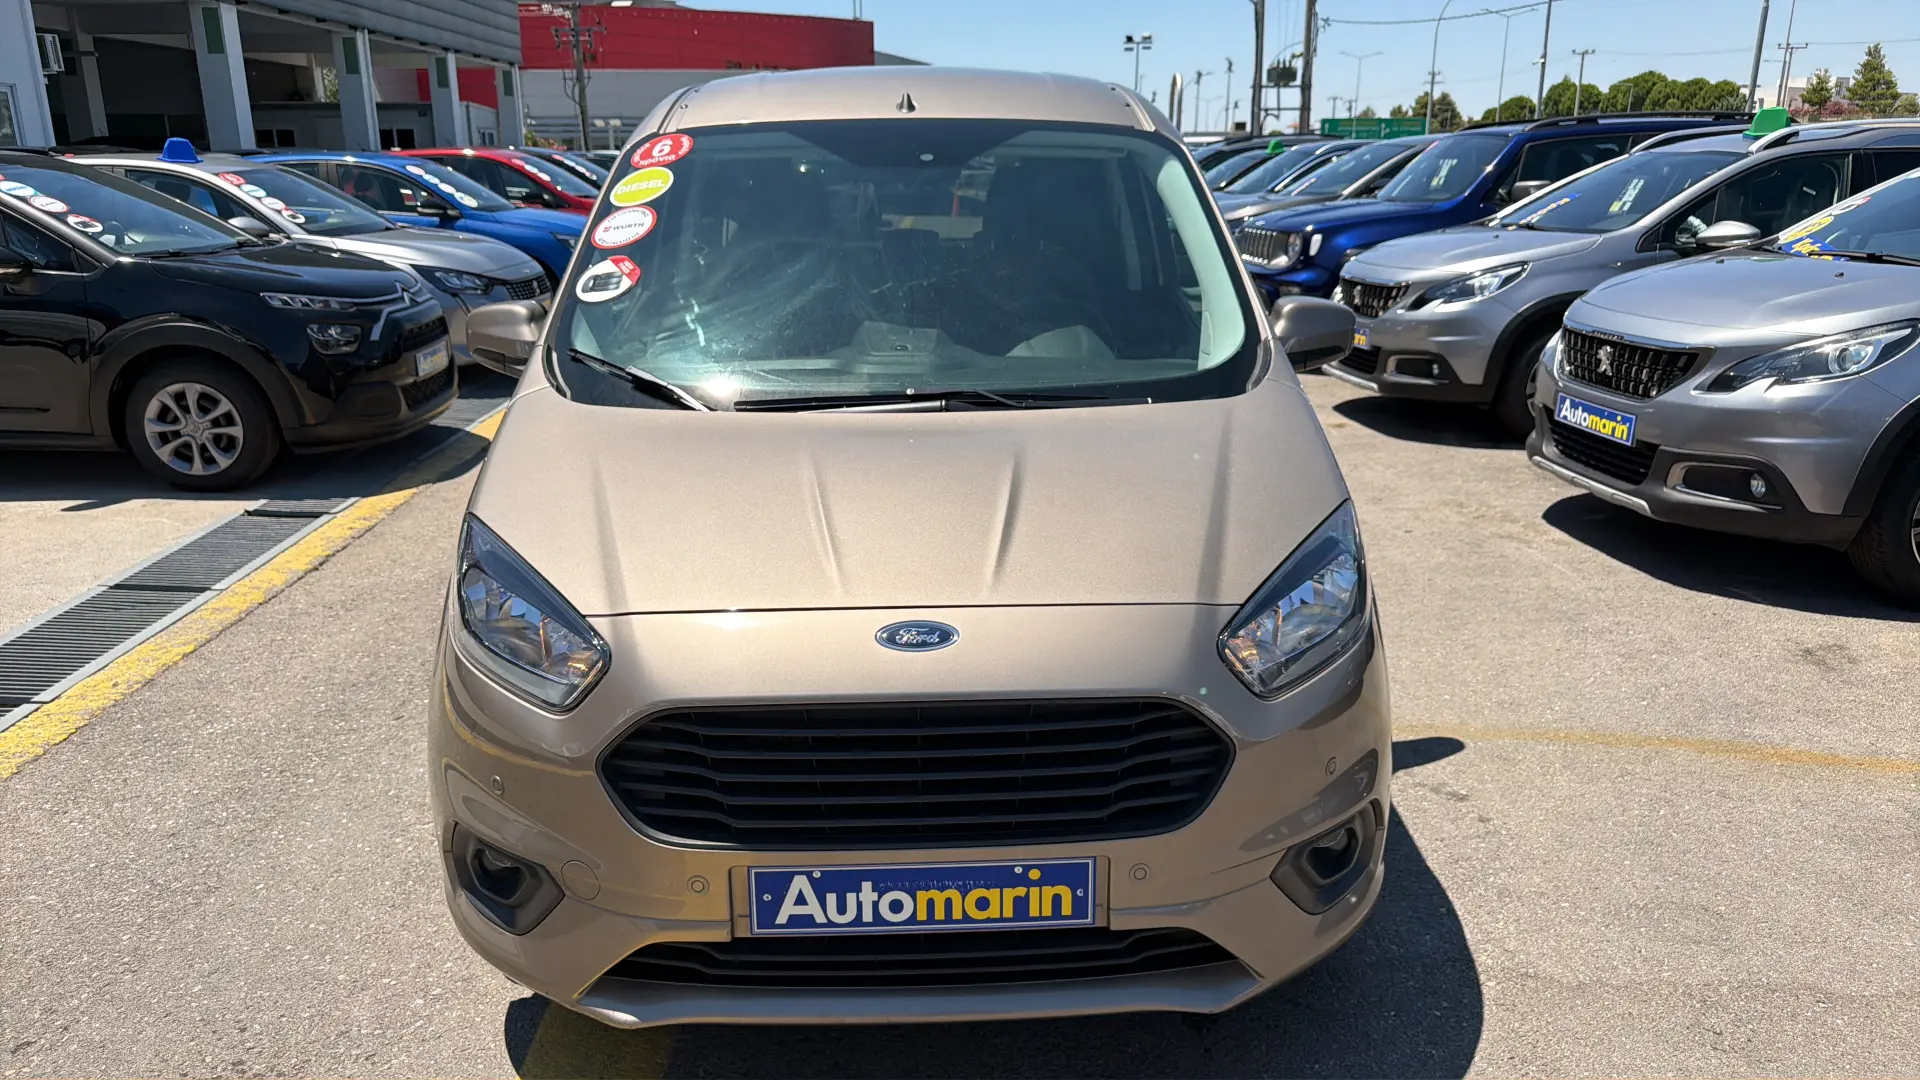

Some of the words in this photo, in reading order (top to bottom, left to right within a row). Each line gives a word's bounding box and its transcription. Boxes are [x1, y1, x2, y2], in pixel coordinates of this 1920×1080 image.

[652, 138, 673, 157] 6
[616, 179, 666, 195] DIESEL
[1560, 398, 1629, 440] Automarin
[896, 627, 940, 644] Ford
[775, 868, 1073, 925] Automarin
